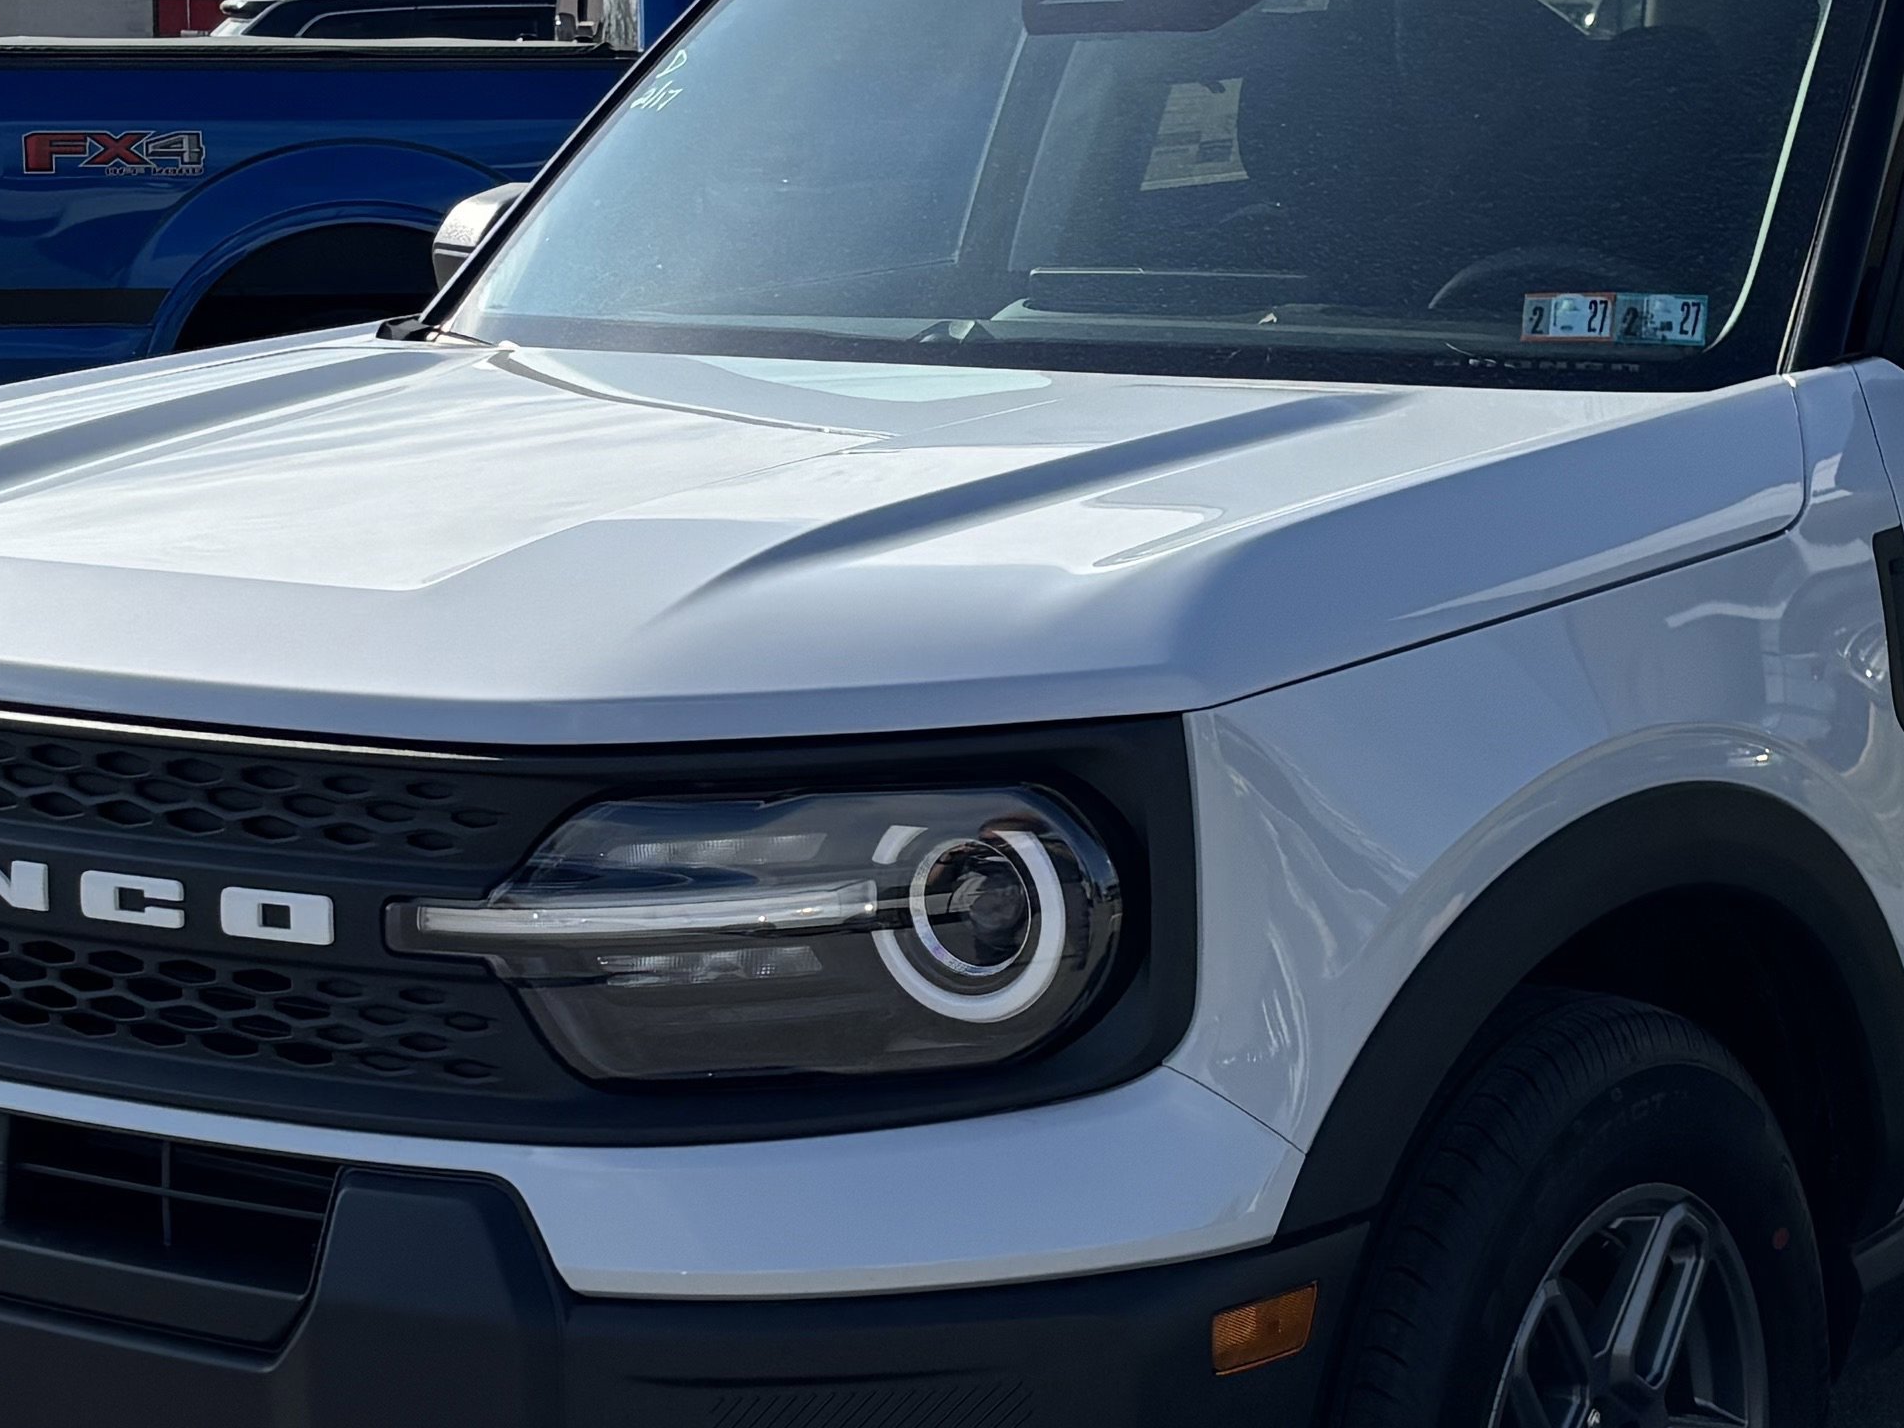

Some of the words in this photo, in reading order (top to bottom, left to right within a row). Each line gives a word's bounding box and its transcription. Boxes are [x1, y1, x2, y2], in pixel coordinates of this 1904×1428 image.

[22, 130, 206, 174] FX4
[1587, 299, 1609, 335] 27
[1679, 301, 1701, 338] 27
